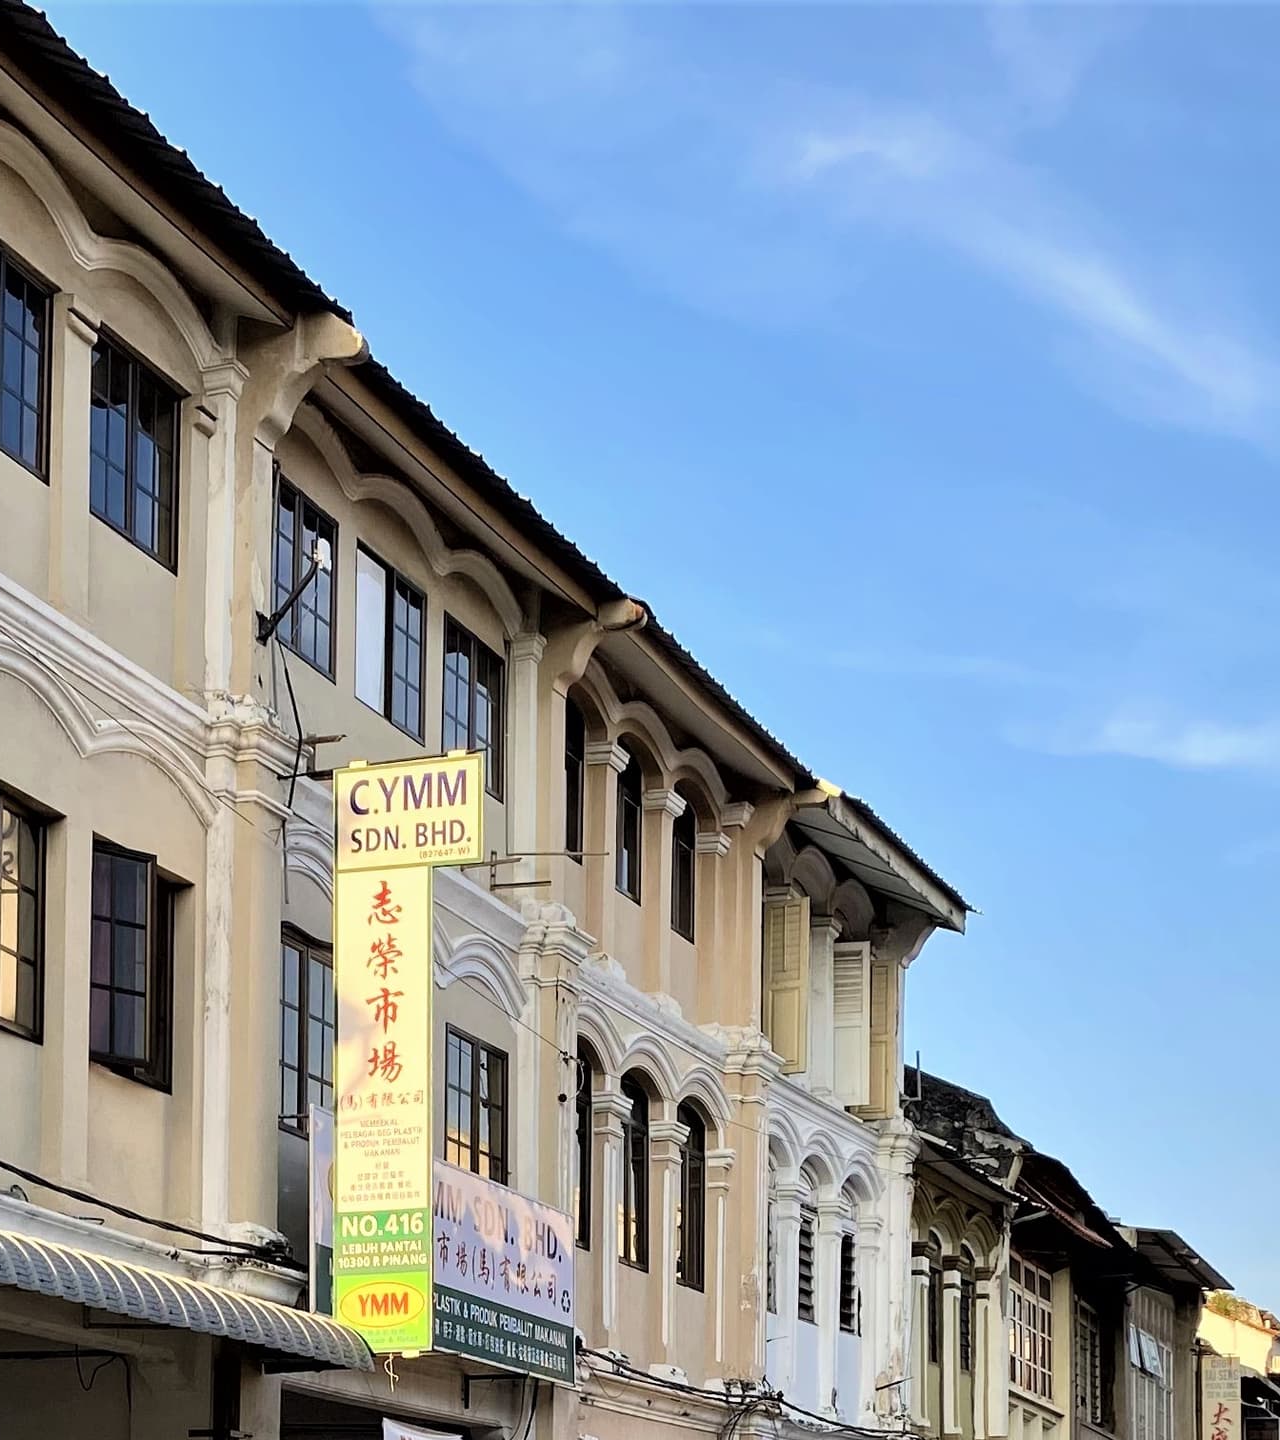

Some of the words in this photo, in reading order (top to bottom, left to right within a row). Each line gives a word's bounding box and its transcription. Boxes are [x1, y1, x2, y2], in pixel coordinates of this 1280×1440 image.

[350, 769, 467, 815] C.YMM
[351, 825, 406, 853] SDN.
[415, 820, 471, 847] BHD.
[366, 880, 404, 1083] 志榮市場
[341, 1212, 424, 1238] NO.416
[474, 1196, 514, 1246] SDN.
[525, 1216, 562, 1264] BHD.
[342, 1242, 378, 1255] LEBUH
[380, 1239, 422, 1253] PANTAI
[338, 1256, 370, 1269] 10300
[382, 1253, 427, 1266] PINANG
[358, 1292, 409, 1317] YMM
[470, 1304, 498, 1328] PRODUK
